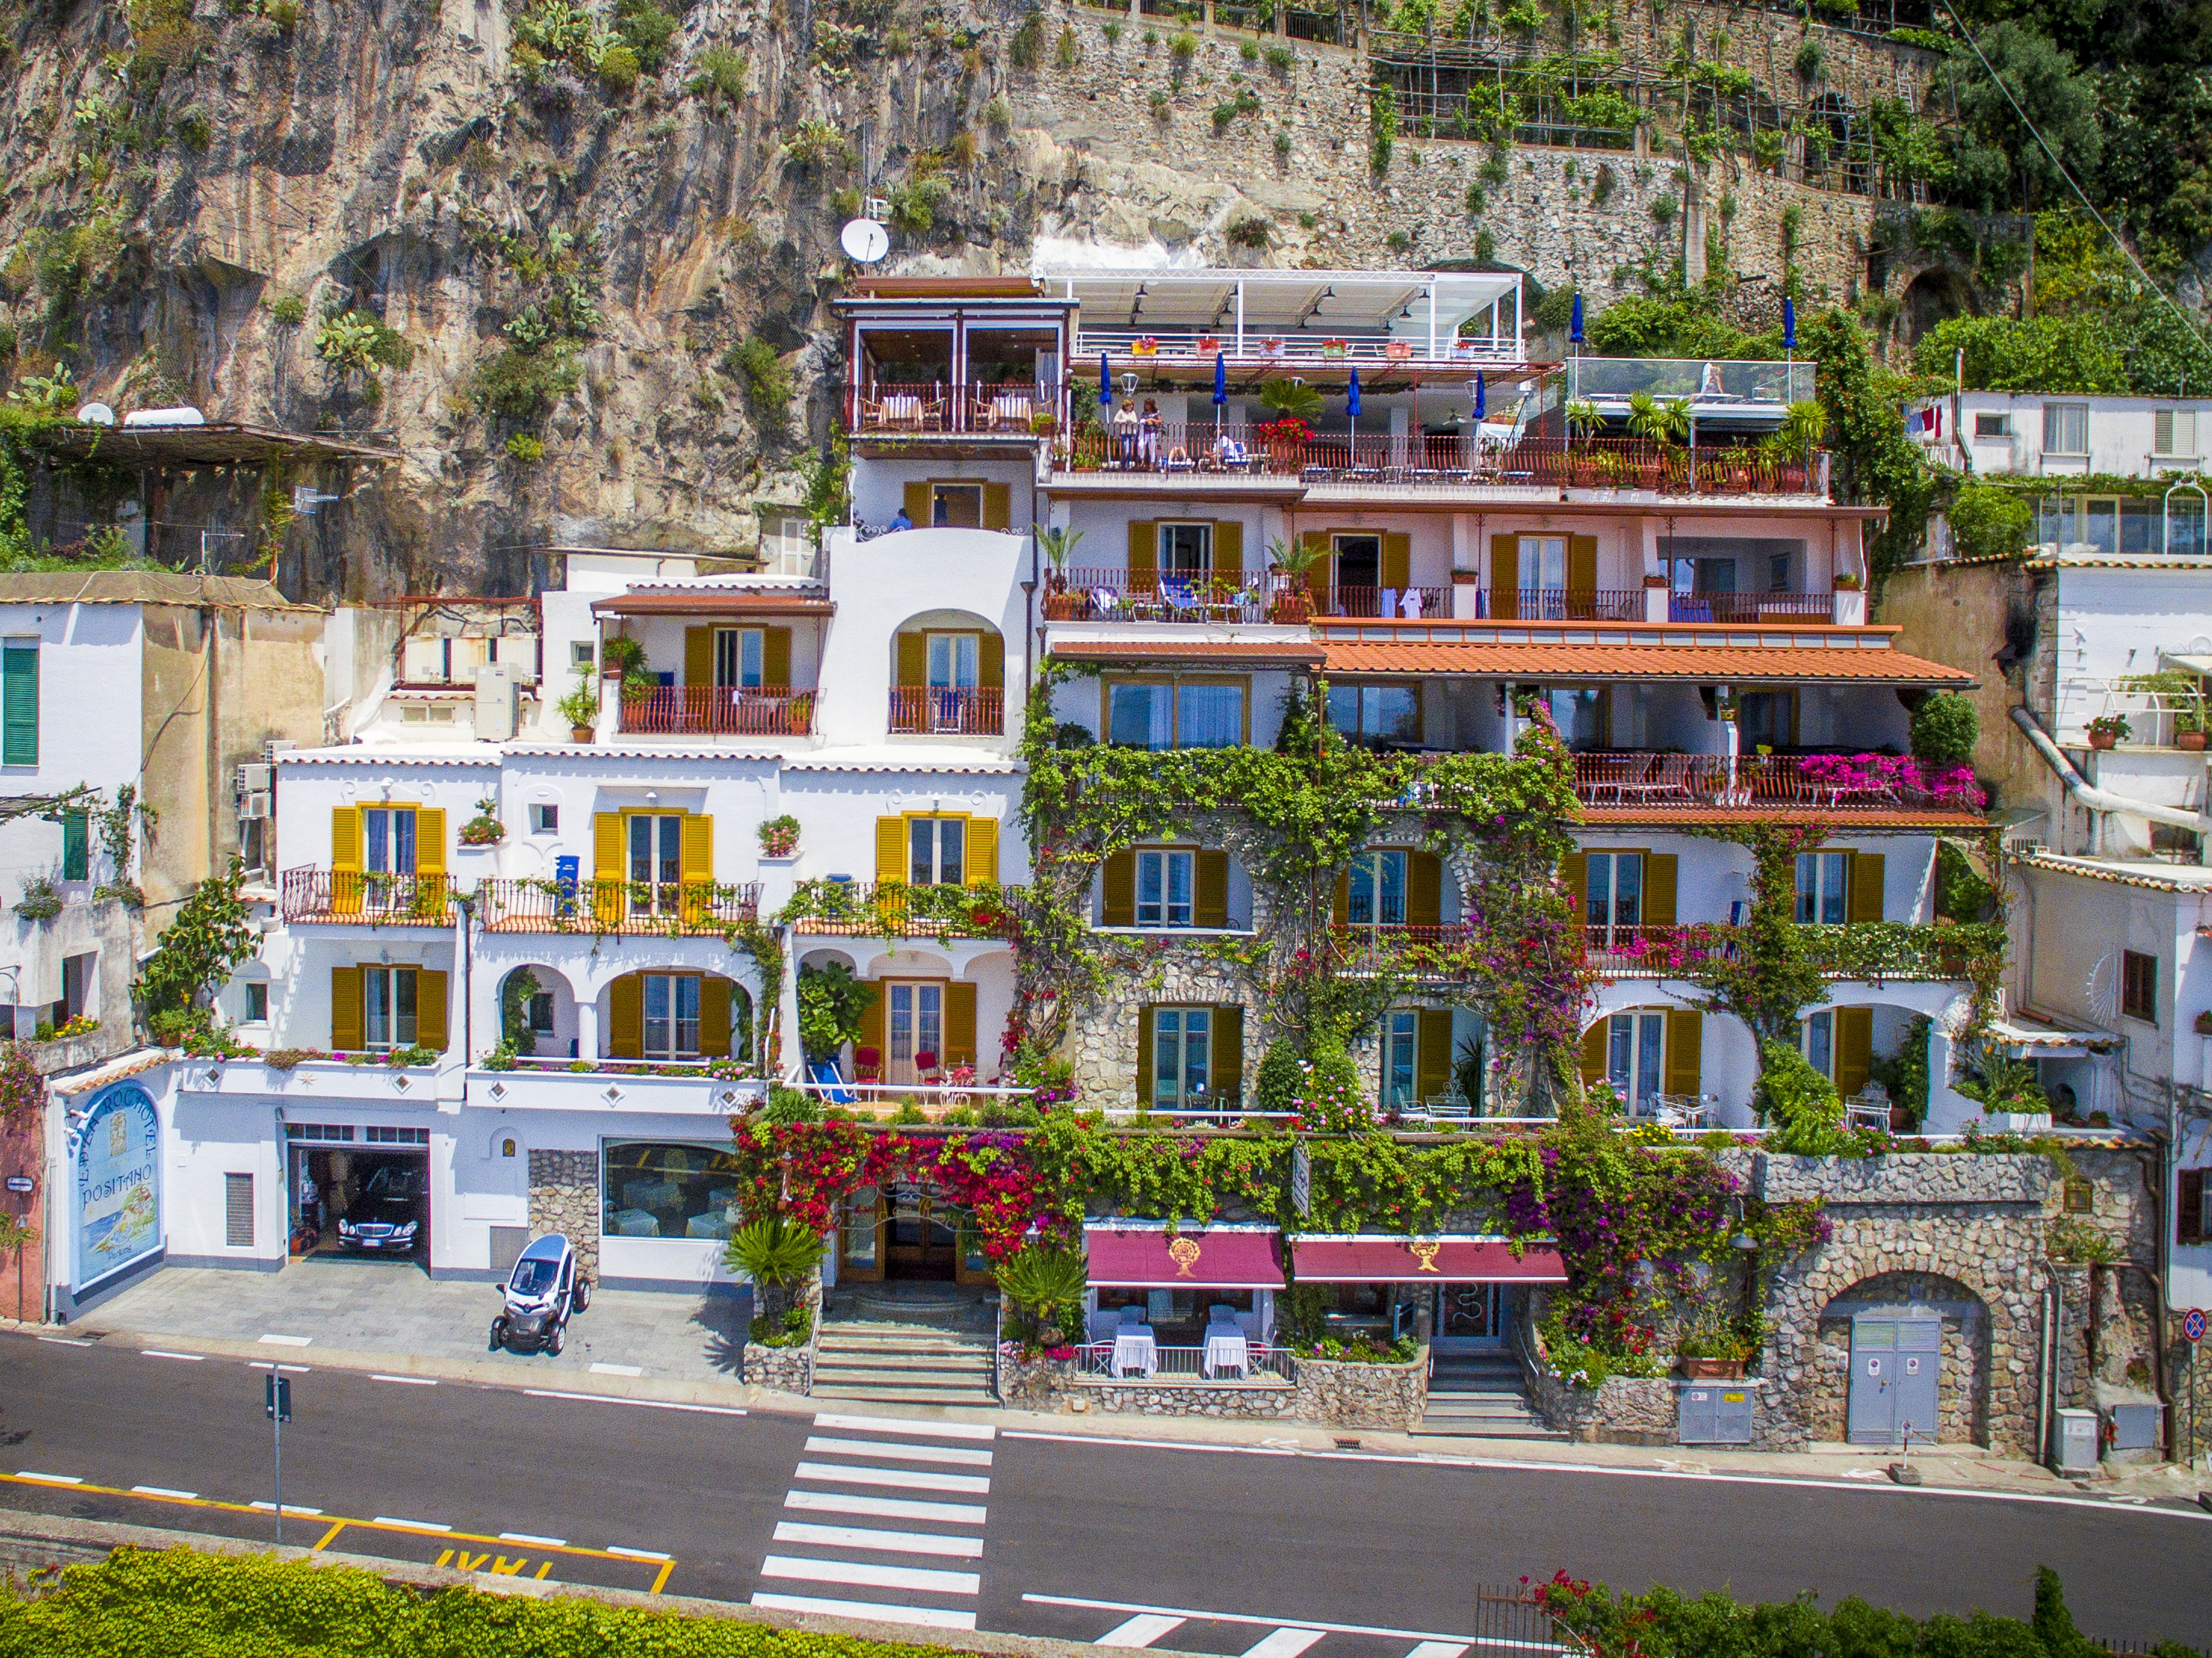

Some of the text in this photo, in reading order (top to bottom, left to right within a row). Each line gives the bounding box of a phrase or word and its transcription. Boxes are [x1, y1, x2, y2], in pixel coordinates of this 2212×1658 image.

[102, 1090, 135, 1113] ROC
[133, 1095, 156, 1159] HOTEL
[82, 1163, 152, 1211] POSITANO
